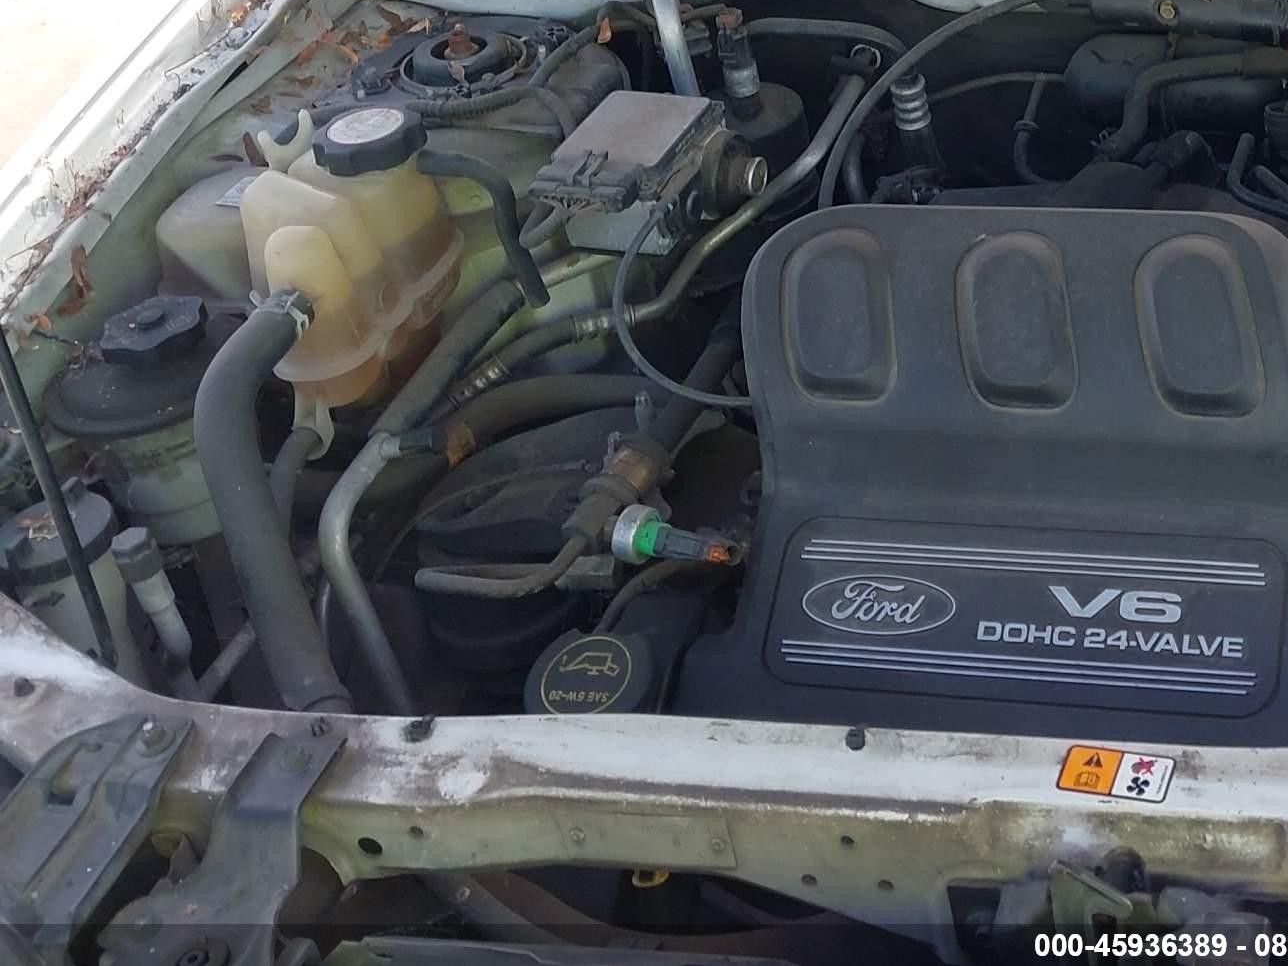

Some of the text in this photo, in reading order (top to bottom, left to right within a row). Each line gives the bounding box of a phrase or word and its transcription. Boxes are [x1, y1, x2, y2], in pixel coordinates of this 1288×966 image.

[830, 579, 927, 626] Ford
[1048, 585, 1184, 624] V6
[976, 620, 1246, 660] DOHC 24-VALVE
[587, 690, 609, 703] SAE
